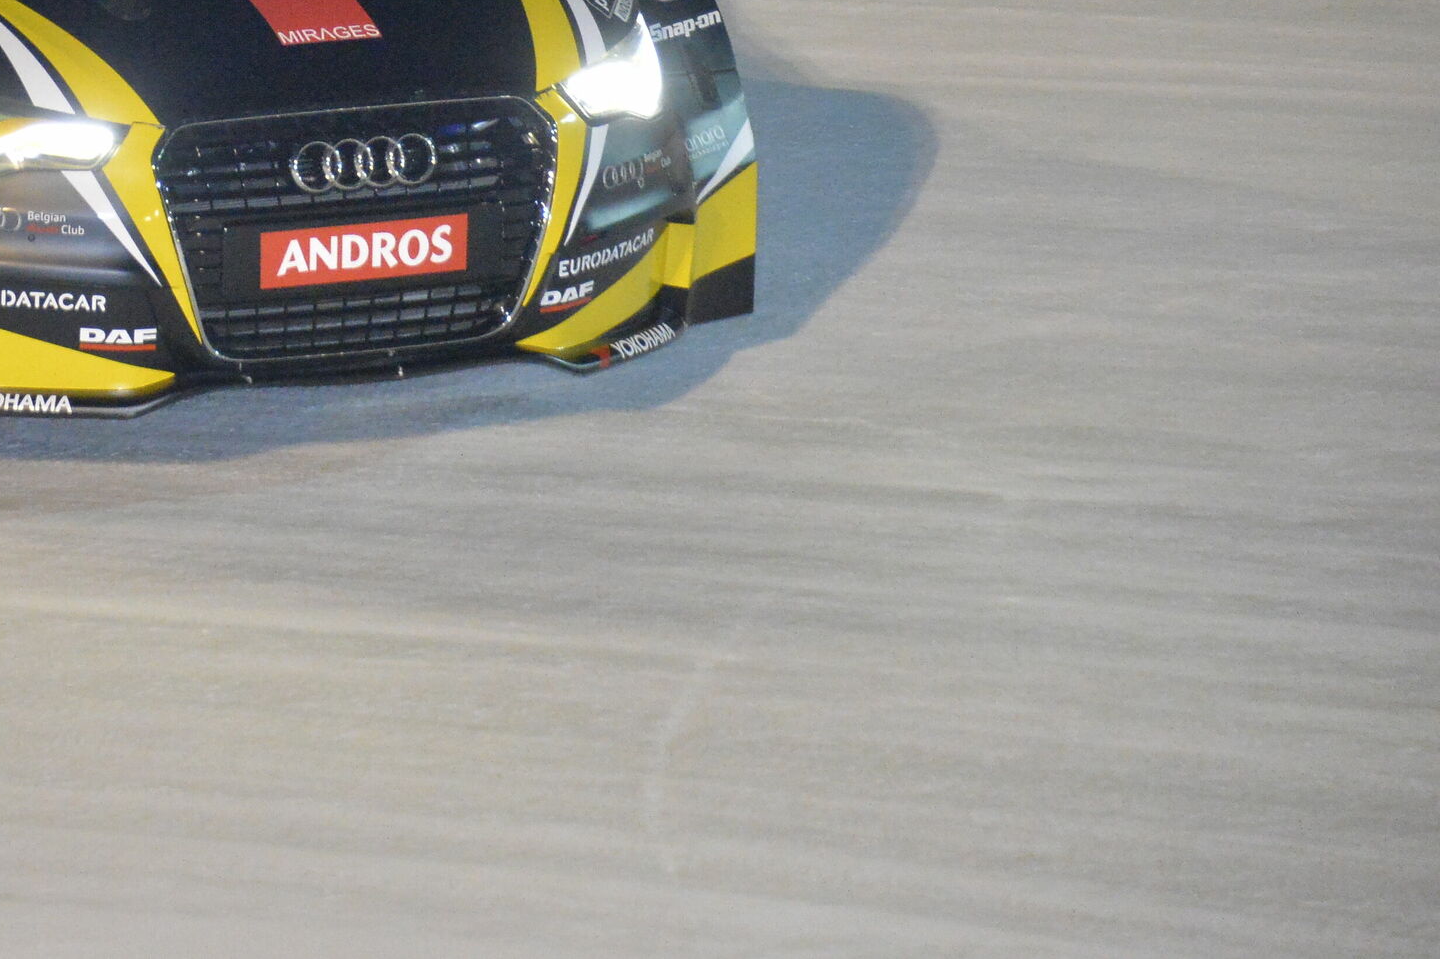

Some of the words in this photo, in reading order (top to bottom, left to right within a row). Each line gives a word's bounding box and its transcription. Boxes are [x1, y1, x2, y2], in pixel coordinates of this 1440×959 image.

[277, 23, 382, 46] MIRAGES
[648, 10, 722, 43] Snap-on
[27, 210, 67, 224] Belgian
[61, 224, 86, 235] Club
[276, 224, 454, 277] ANDROS
[558, 228, 655, 278] EURODATACAR
[540, 280, 595, 306] DAF
[79, 327, 157, 344] DAF
[610, 322, 677, 359] YOKOHAMA
